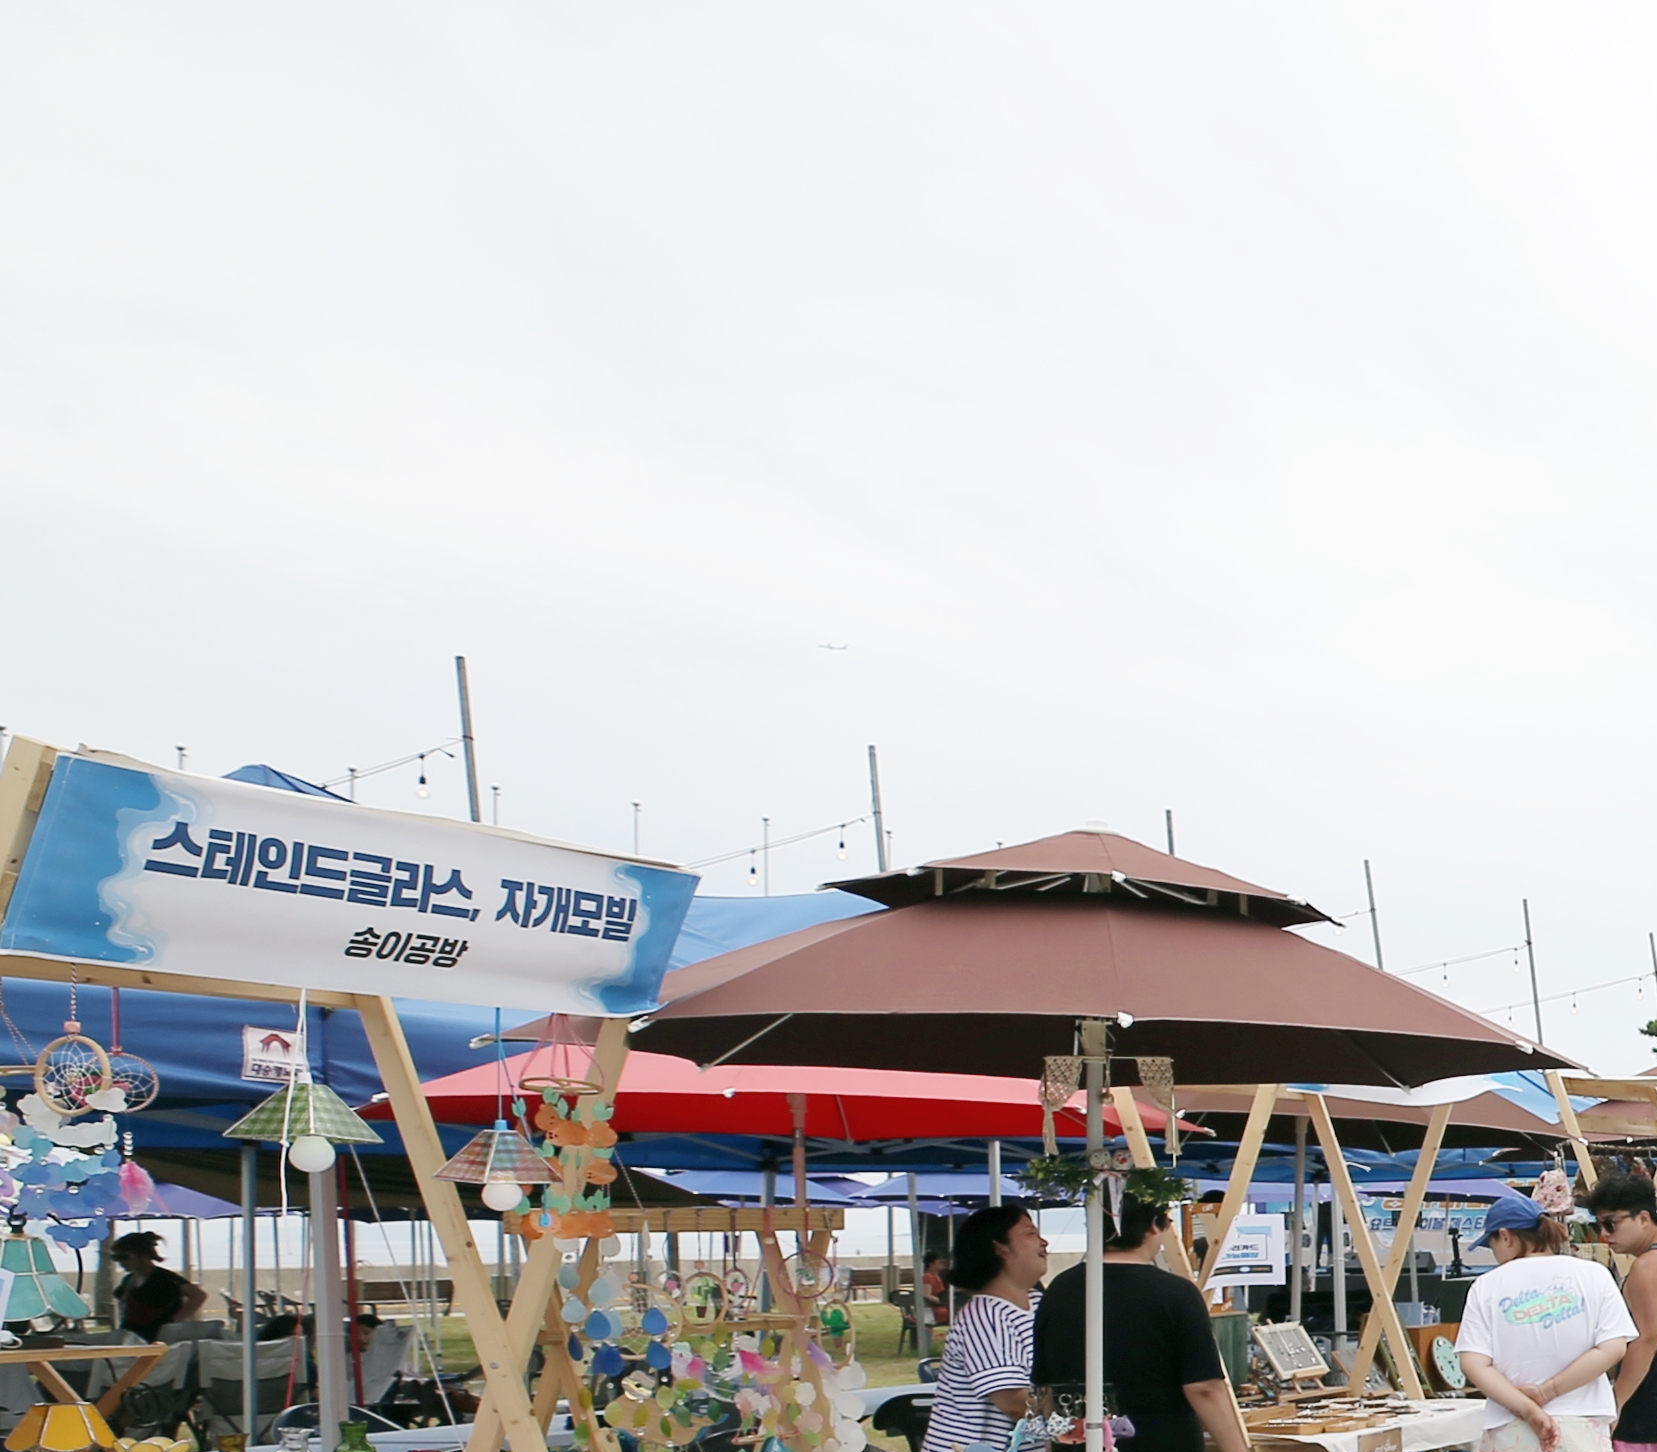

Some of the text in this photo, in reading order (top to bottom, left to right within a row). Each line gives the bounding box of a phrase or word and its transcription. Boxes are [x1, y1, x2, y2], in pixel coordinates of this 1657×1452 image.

[143, 821, 638, 942] 스테인드글라스, 자개모빌
[344, 926, 470, 968] 송이공방
[1499, 1287, 1541, 1313] Delta
[1512, 1294, 1573, 1321] DELTA
[1540, 1296, 1586, 1329] Delta!
